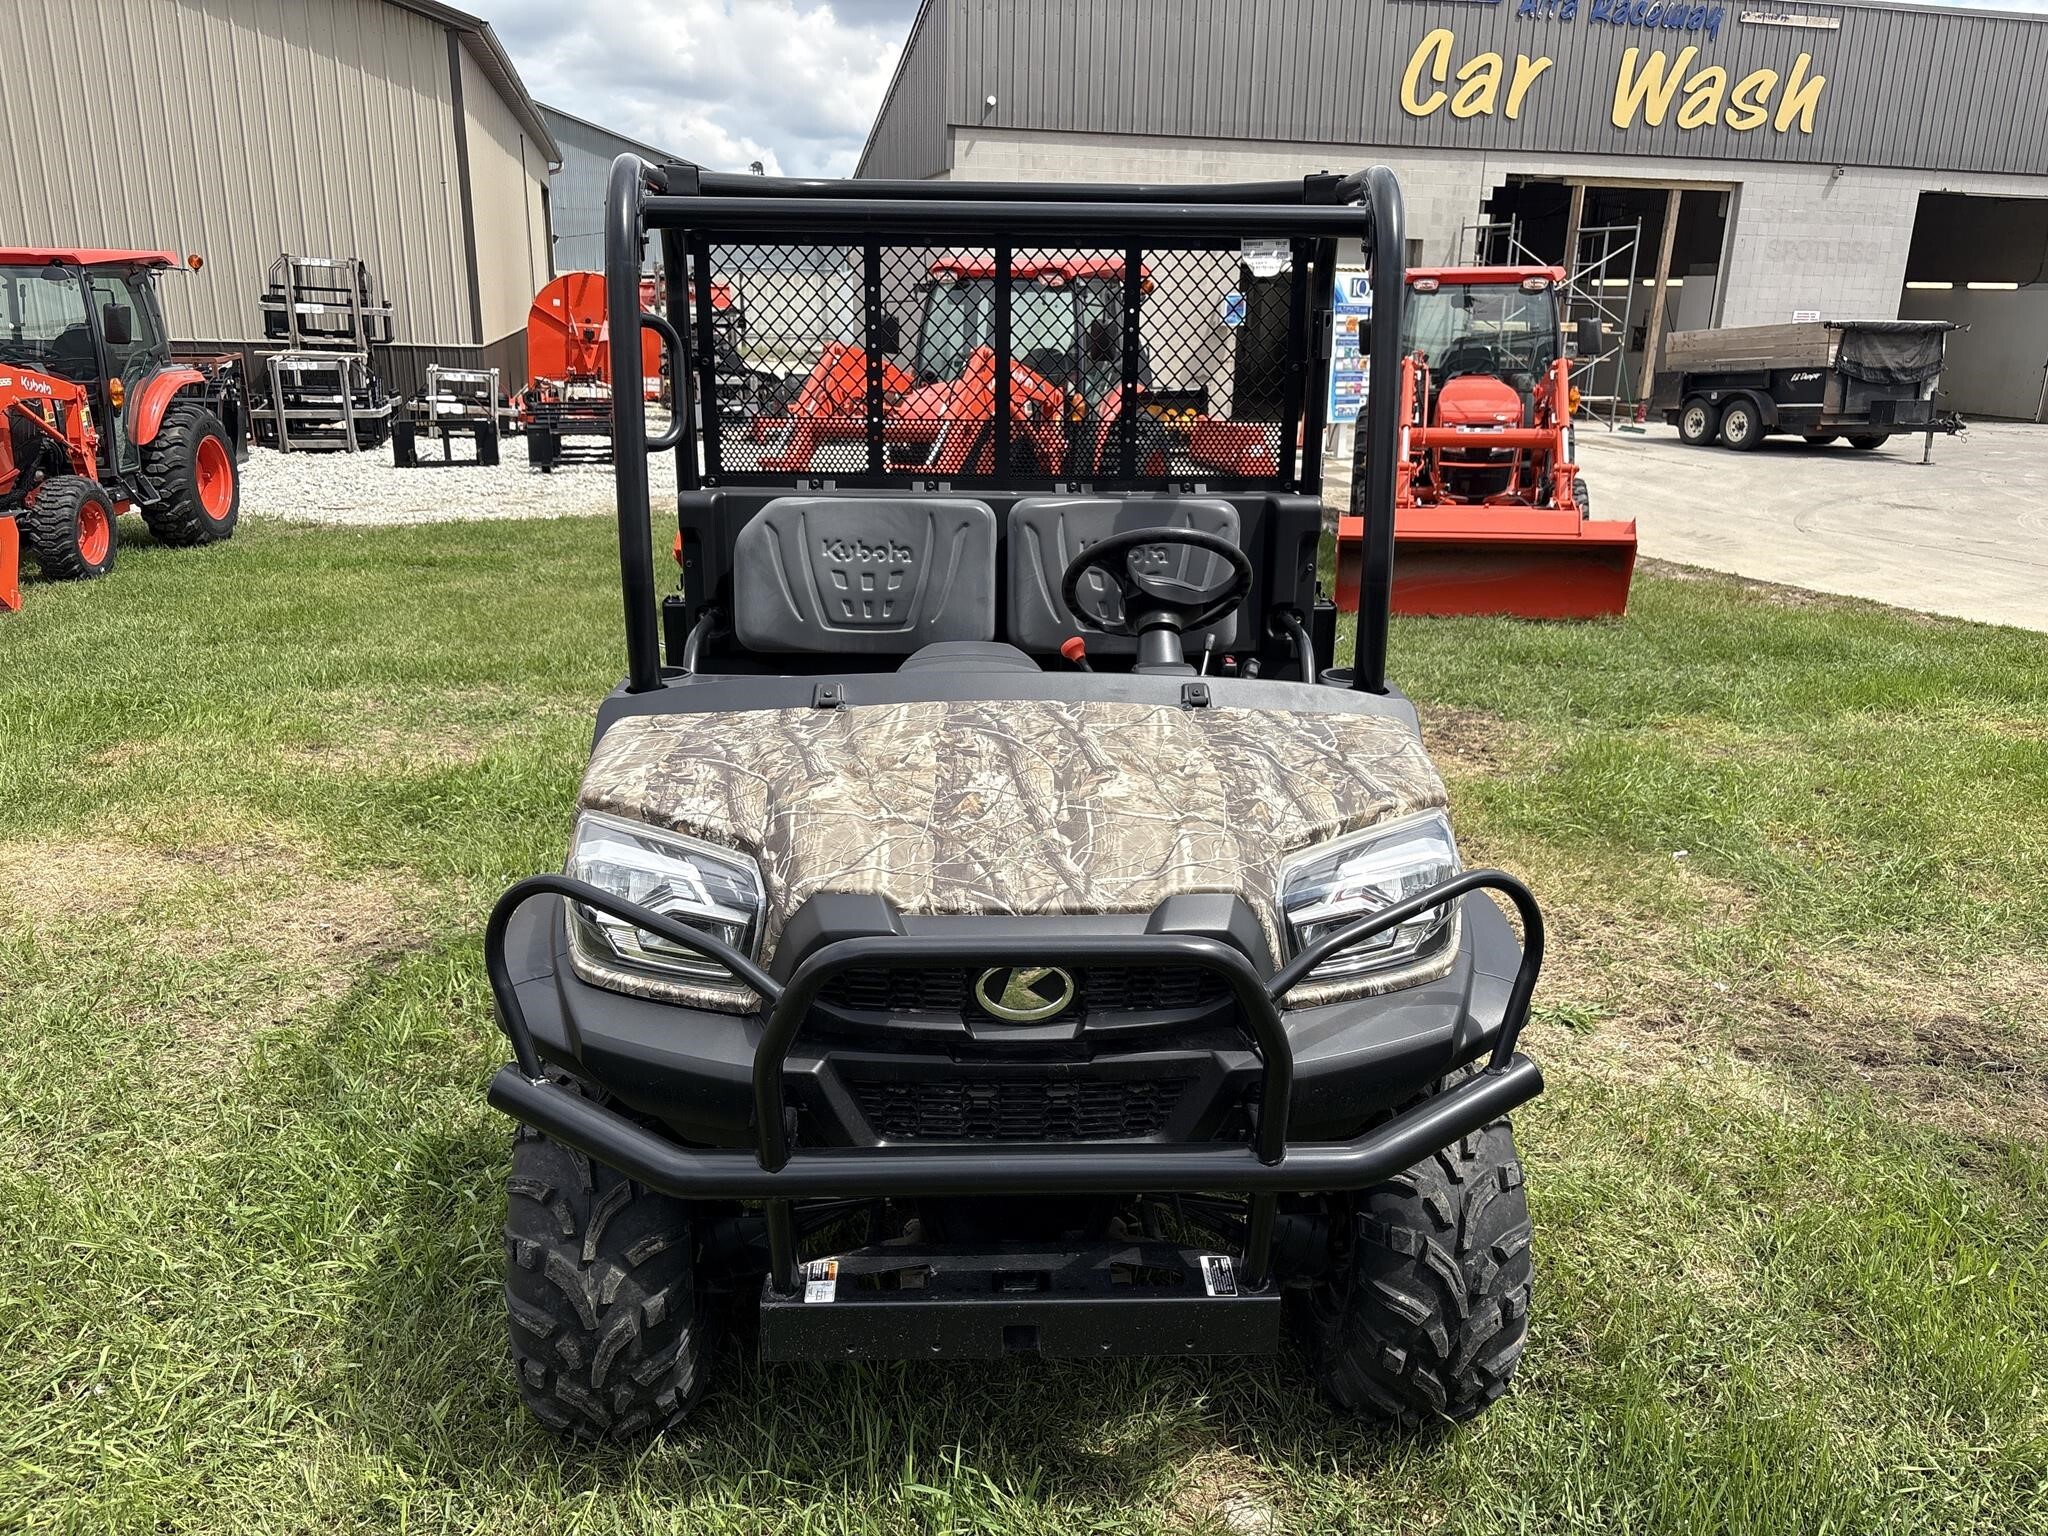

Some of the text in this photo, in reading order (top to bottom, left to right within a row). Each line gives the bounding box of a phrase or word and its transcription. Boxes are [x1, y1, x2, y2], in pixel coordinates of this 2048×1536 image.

[1590, 0, 1726, 41] Raceway
[1400, 28, 1827, 133] Car Wash
[1352, 279, 1370, 298] IQ
[20, 375, 52, 395] Kubota
[822, 539, 913, 563] Kubota
